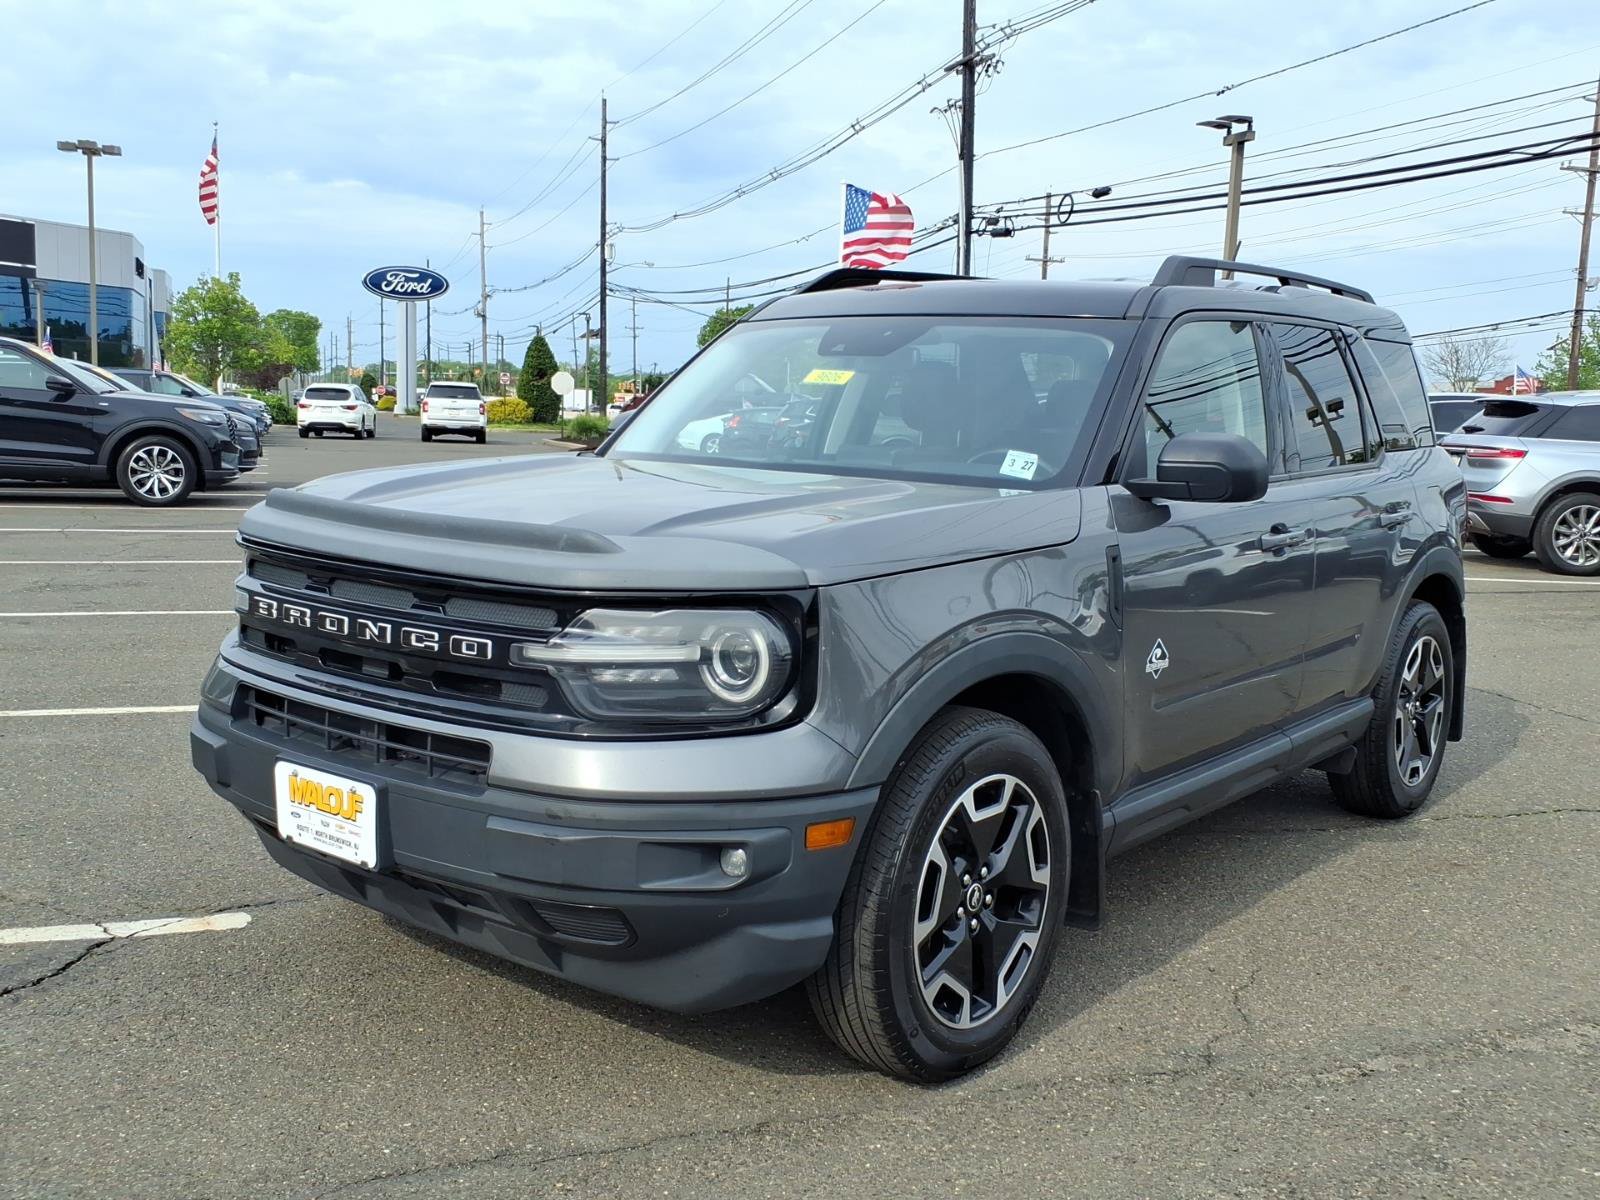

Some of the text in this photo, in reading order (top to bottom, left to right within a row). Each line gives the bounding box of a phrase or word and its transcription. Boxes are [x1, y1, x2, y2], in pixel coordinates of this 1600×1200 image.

[382, 271, 433, 293] Ford
[1008, 459, 1035, 472] 3 27
[254, 597, 493, 660] BRONCO
[288, 775, 364, 822] MALOUF
